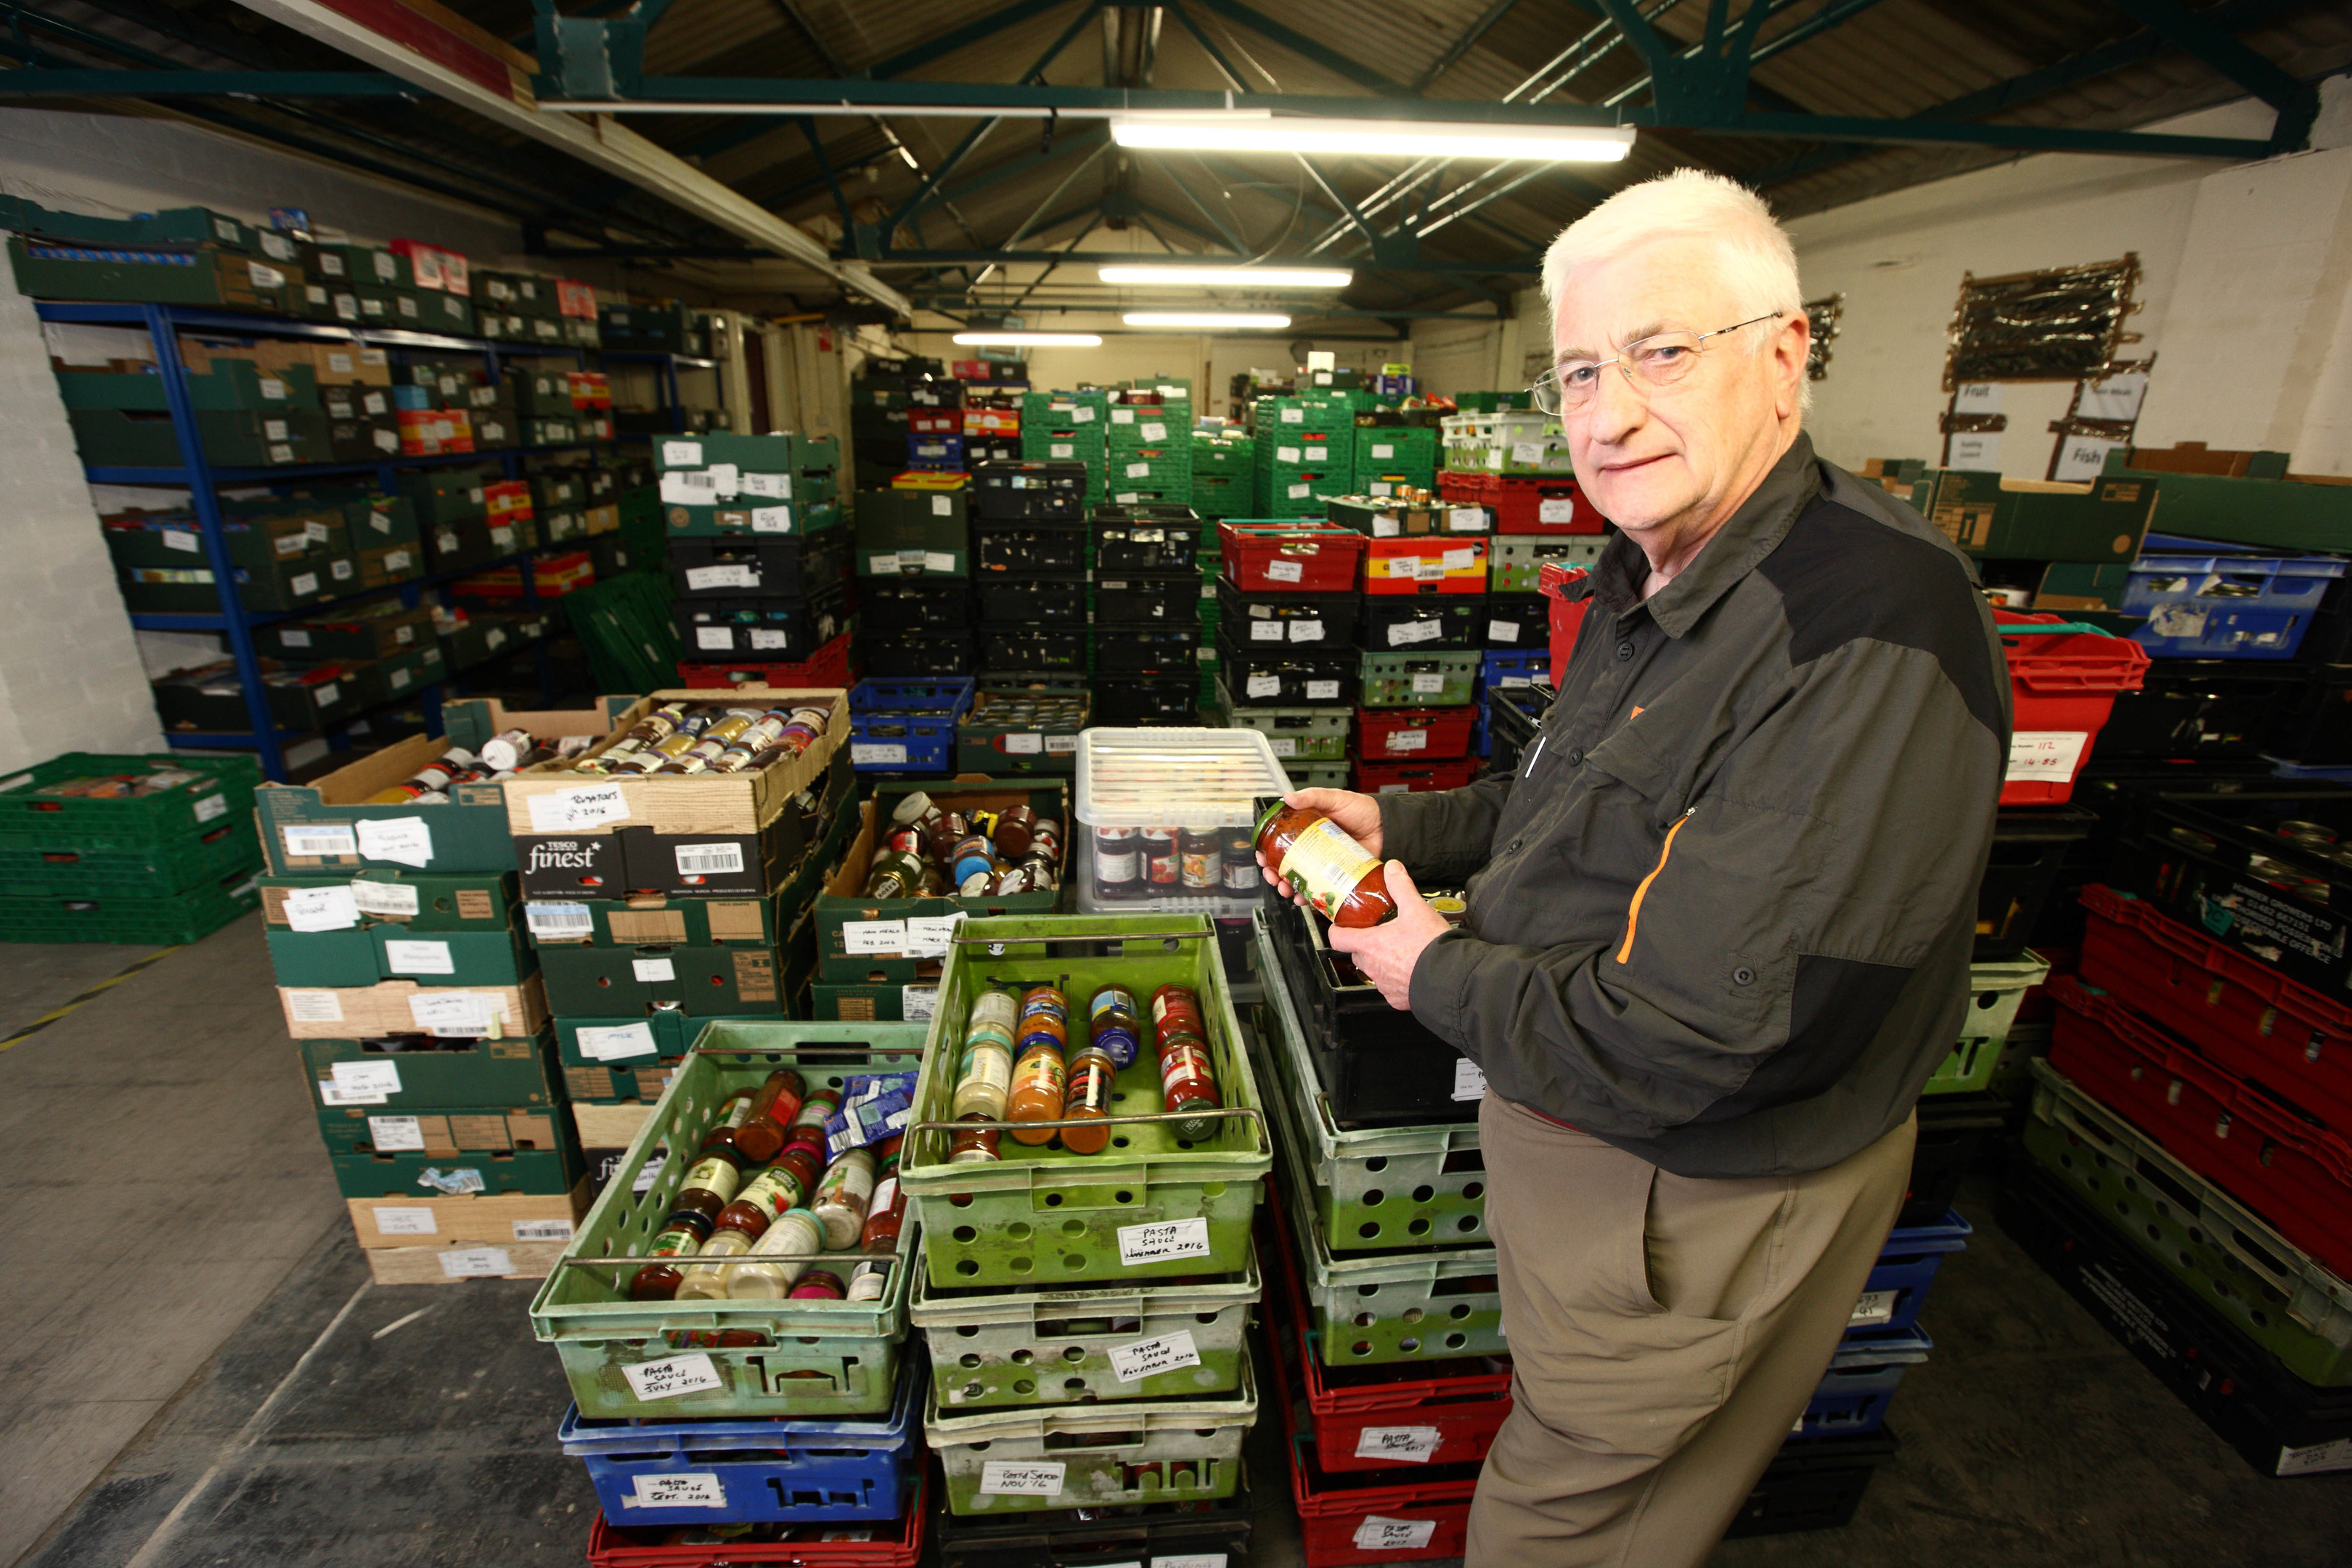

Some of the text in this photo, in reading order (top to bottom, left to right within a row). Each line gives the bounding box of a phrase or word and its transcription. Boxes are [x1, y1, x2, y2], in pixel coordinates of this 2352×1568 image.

[1963, 385, 1990, 396] Fruit
[2073, 448, 2101, 464] Fish
[583, 806, 606, 816] 2016
[546, 841, 579, 849] TESCO
[524, 844, 594, 875] finest
[2269, 899, 2314, 923] GROWERS
[2314, 918, 2332, 931] LTD
[2275, 921, 2332, 953] POSSESSON
[2288, 939, 2332, 965] OFFECE
[1143, 1225, 1177, 1238] PASTA
[1142, 1236, 1175, 1246] SAUCE
[1177, 1242, 1204, 1251] 2016
[1132, 1341, 1161, 1356] PASTA
[1142, 1347, 1170, 1362] SAUCE
[1175, 1352, 1195, 1362] 2016
[643, 1363, 673, 1378] PASTA
[654, 1369, 687, 1381] SAUCE
[644, 1376, 706, 1393] JULY 2016
[1381, 1433, 1411, 1445] PASTA
